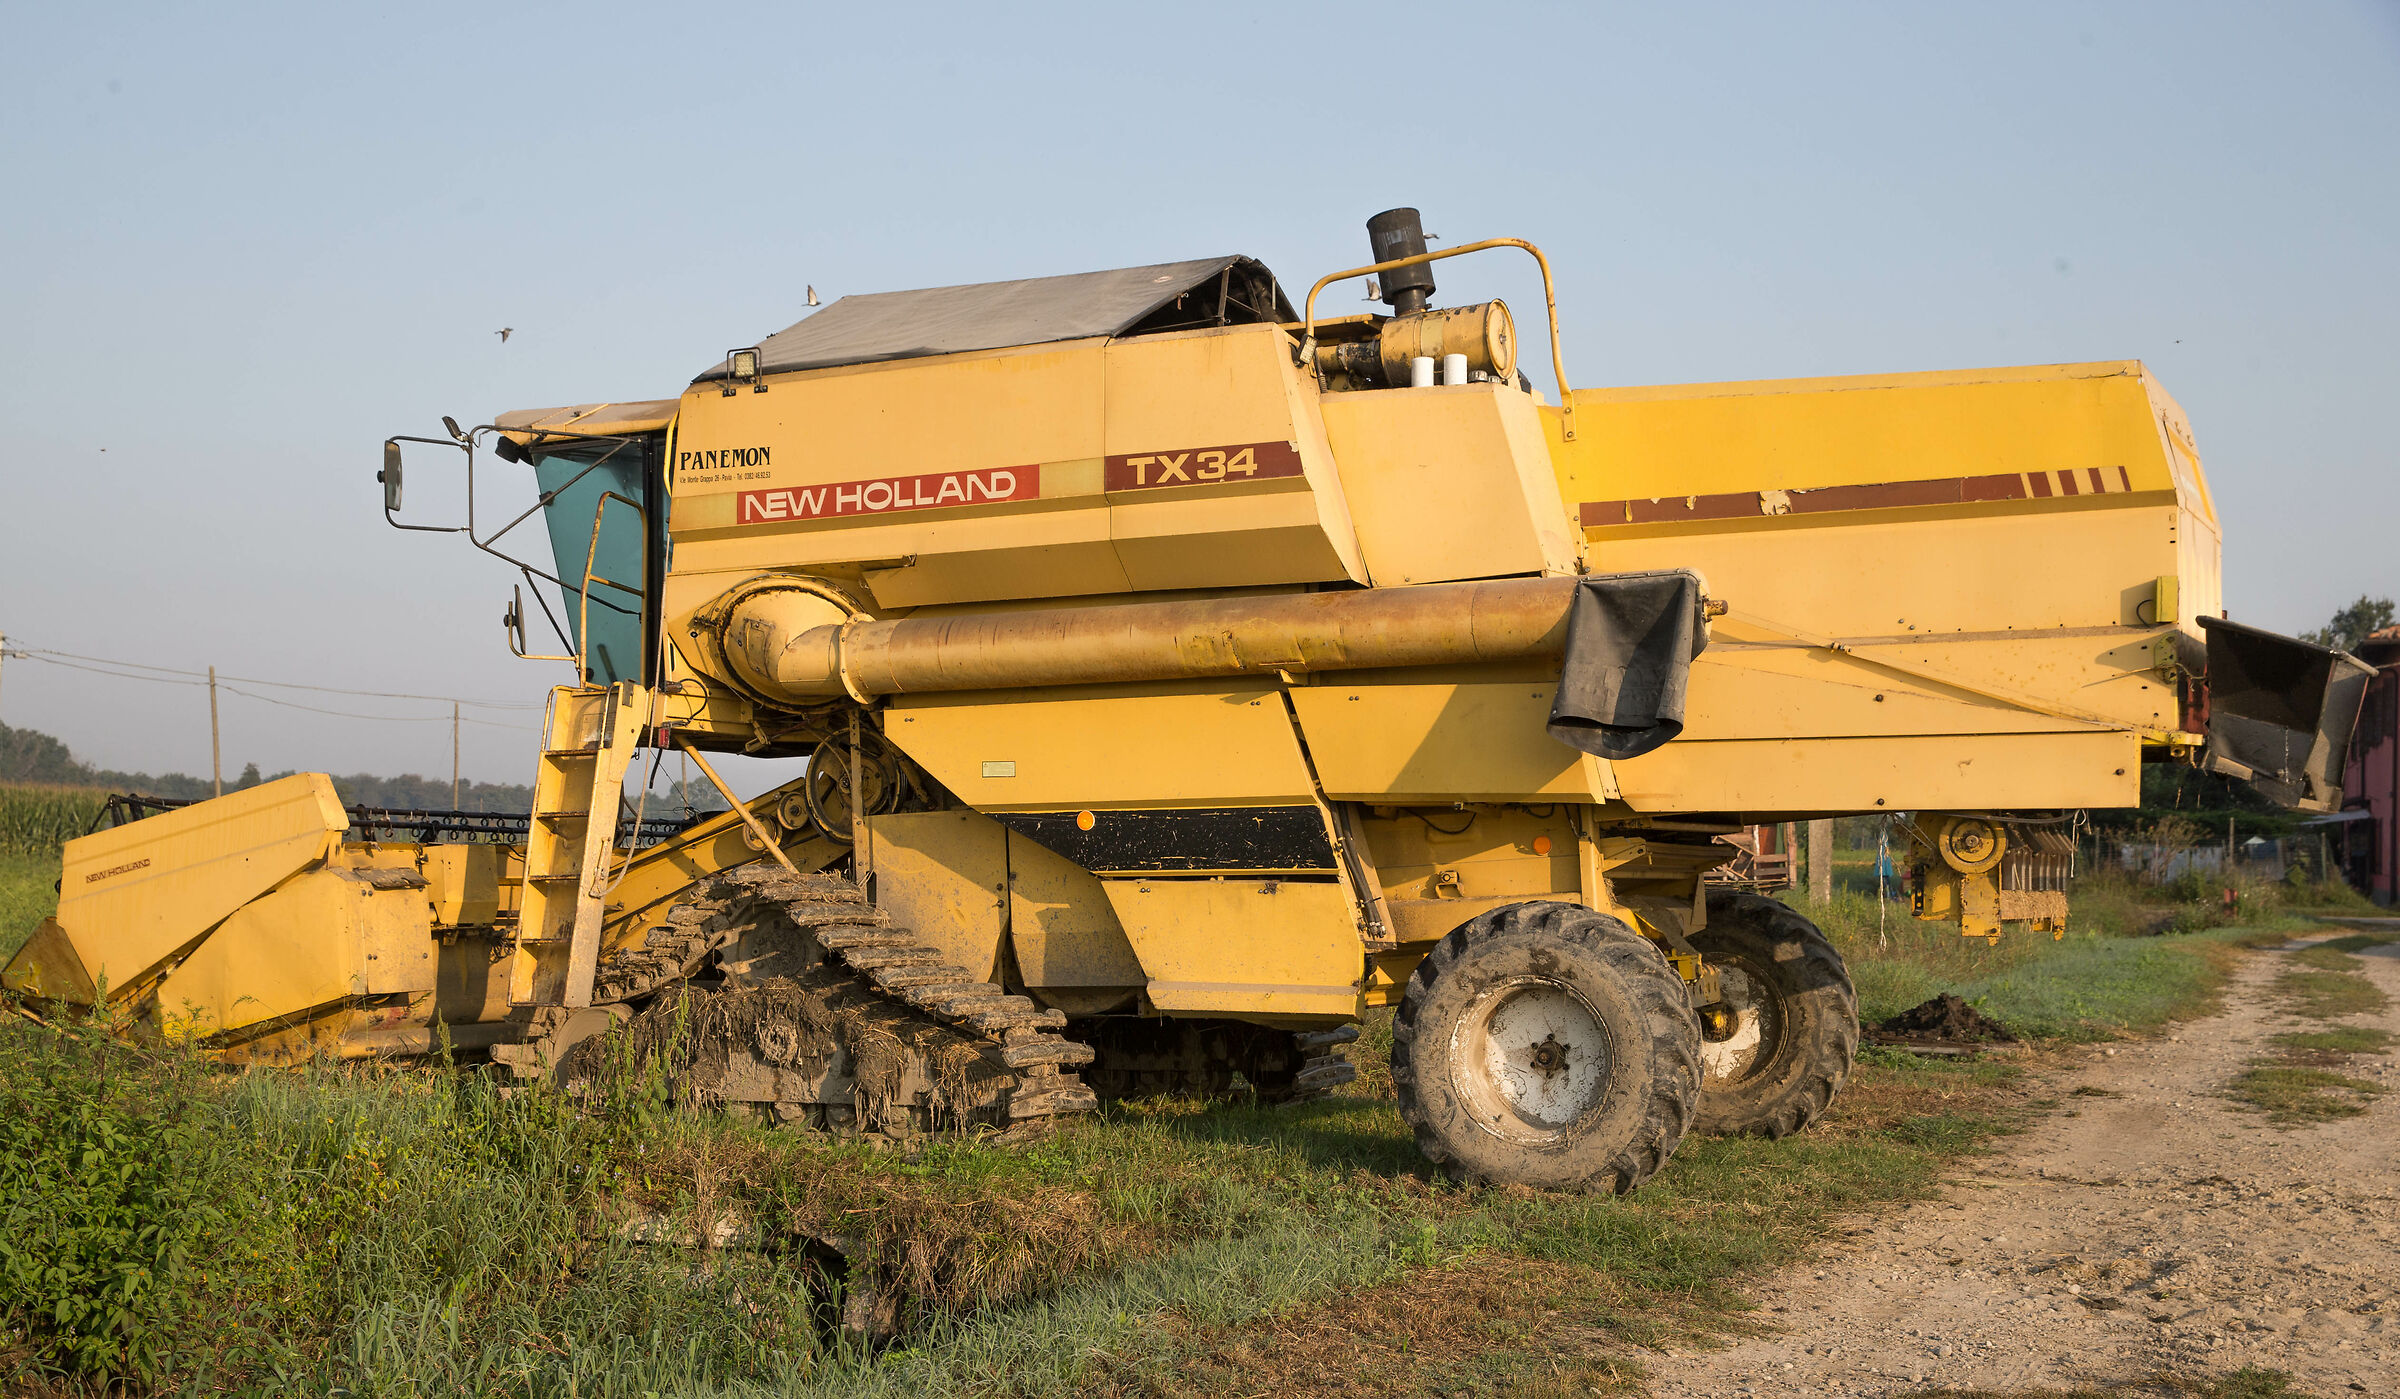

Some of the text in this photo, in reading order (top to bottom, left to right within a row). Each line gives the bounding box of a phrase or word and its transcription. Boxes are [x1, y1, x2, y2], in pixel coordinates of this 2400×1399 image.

[680, 447, 770, 470] PANEMON
[700, 475, 714, 484] Grappa
[745, 471, 1016, 520] NEW HOLLAND
[85, 858, 151, 884] NEW HOLLAND
